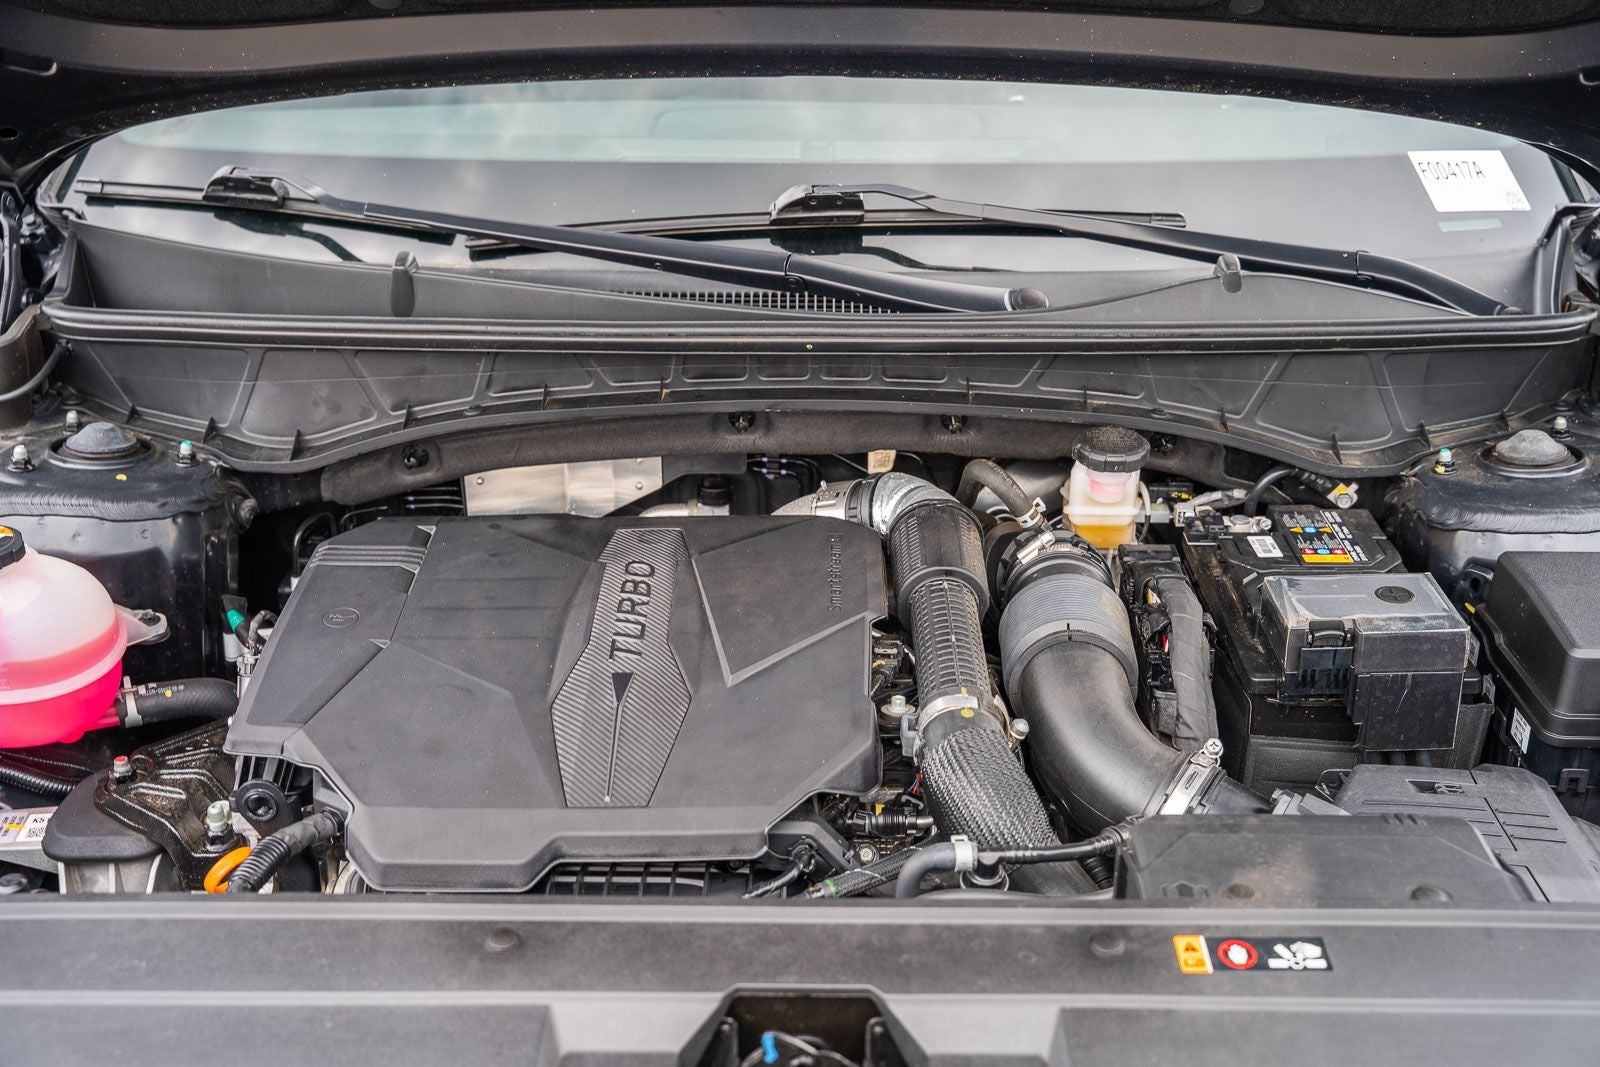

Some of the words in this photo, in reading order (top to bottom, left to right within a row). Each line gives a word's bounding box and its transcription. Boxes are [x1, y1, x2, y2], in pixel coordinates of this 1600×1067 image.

[1418, 161, 1486, 179] F00417A
[609, 560, 656, 660] TURBO
[826, 544, 842, 612] Smartstream
